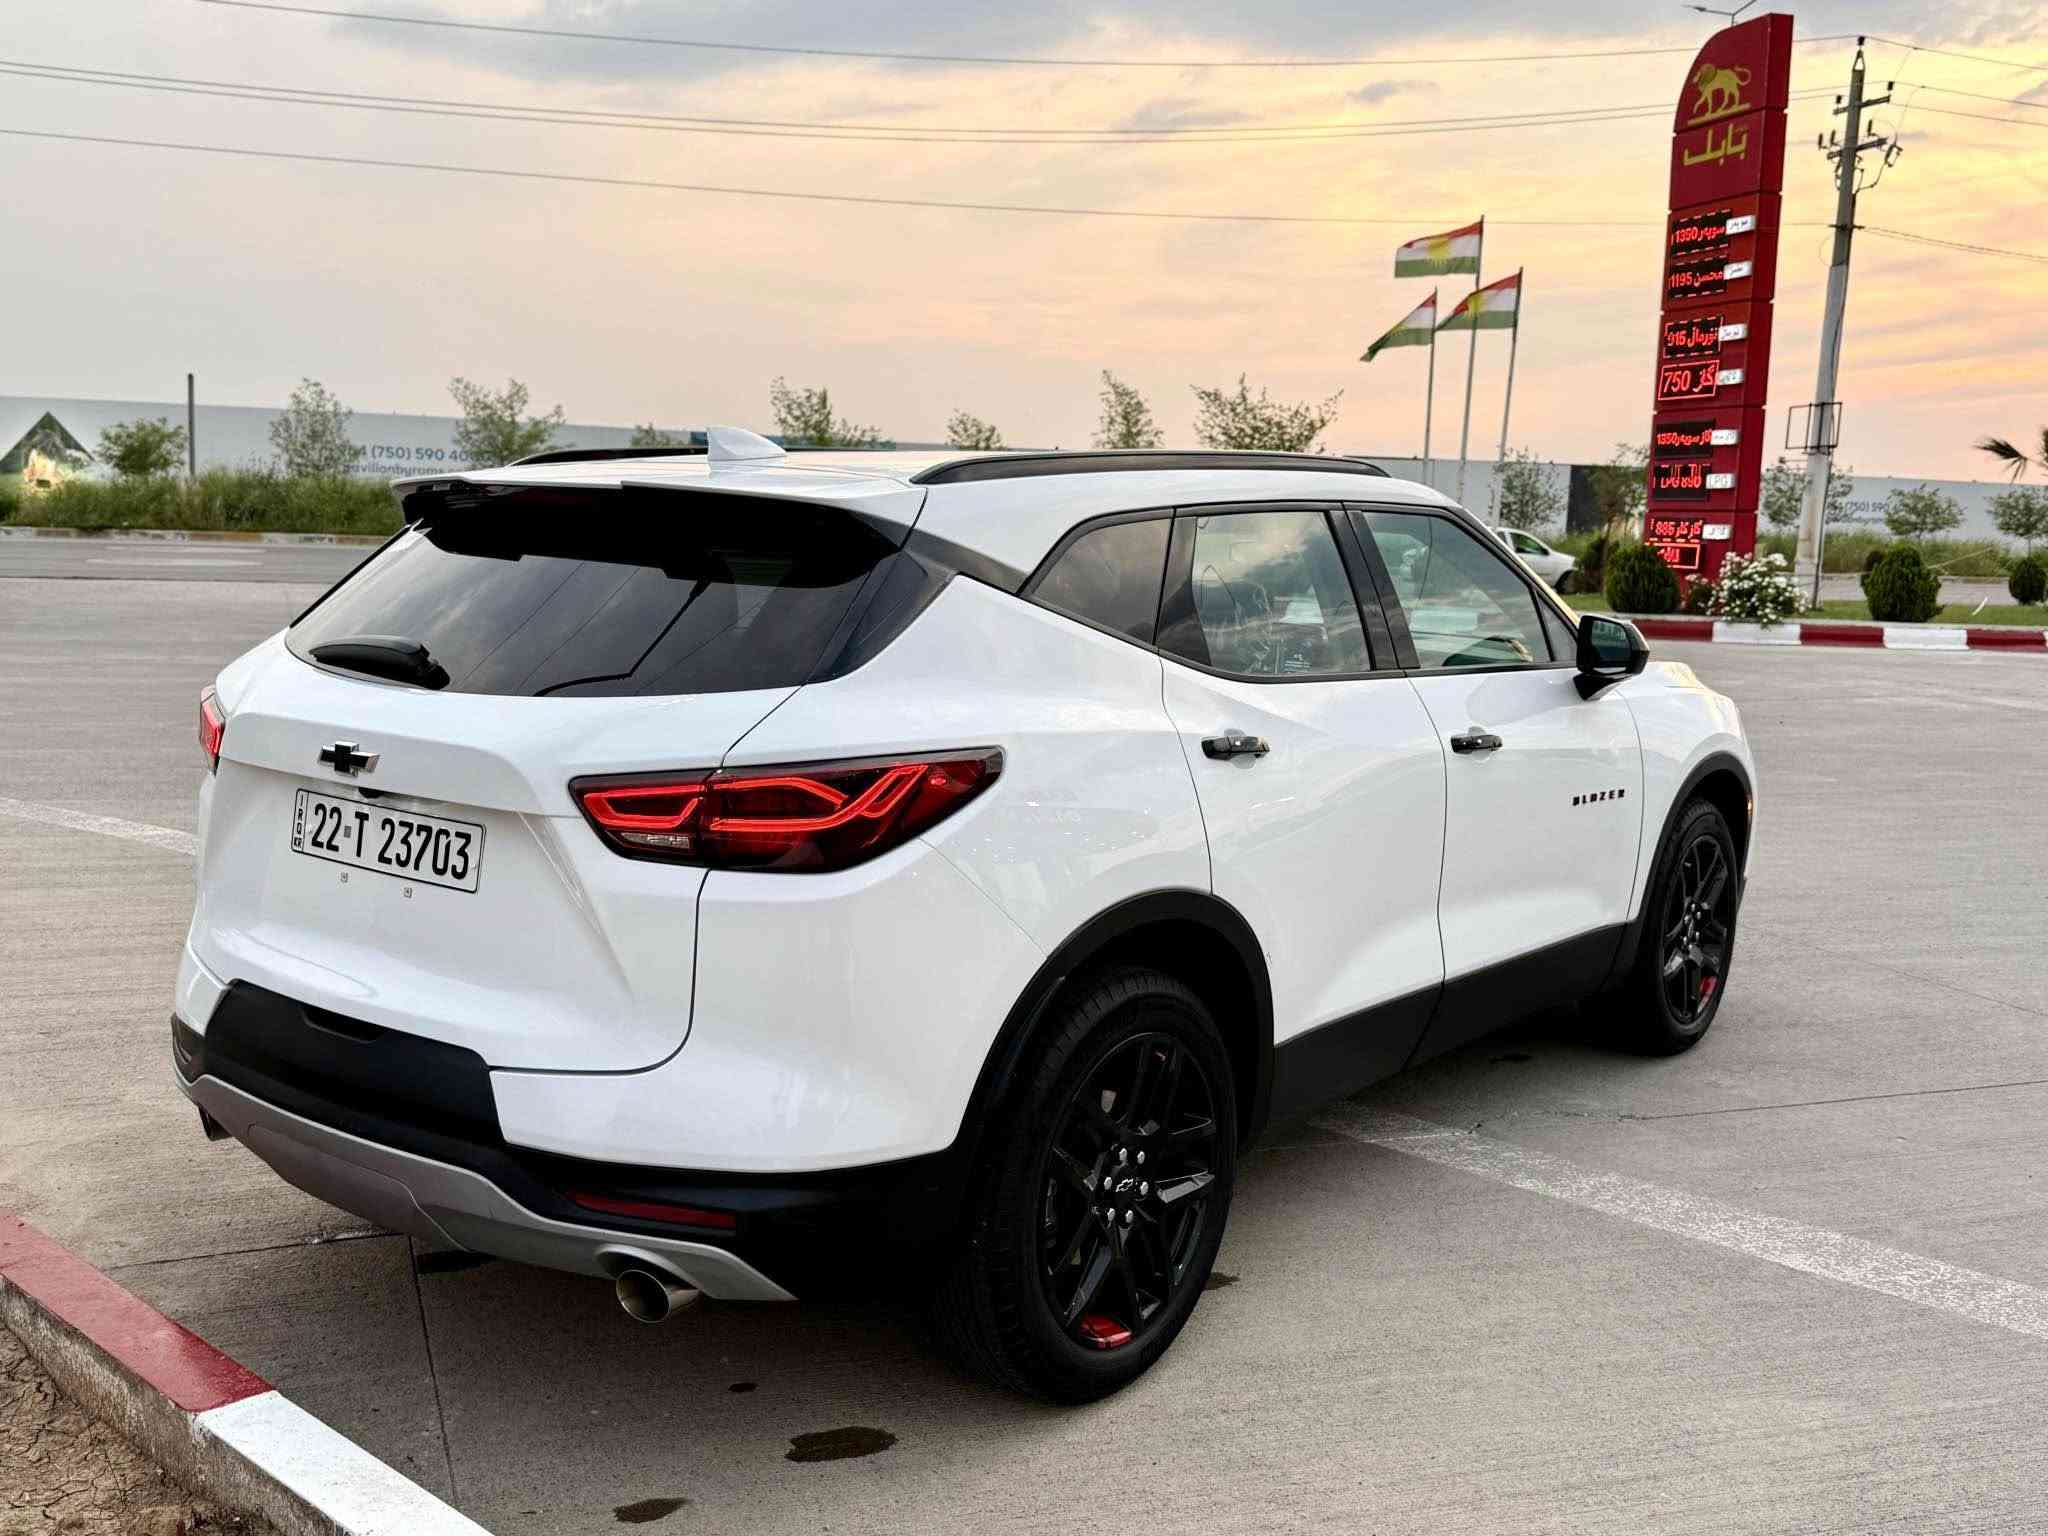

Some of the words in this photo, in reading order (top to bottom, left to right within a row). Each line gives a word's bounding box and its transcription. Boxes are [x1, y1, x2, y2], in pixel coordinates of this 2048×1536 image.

[1664, 370, 1692, 393] 750
[371, 445, 411, 460] (750)
[415, 447, 445, 461] 590
[377, 817, 472, 880] 23703
